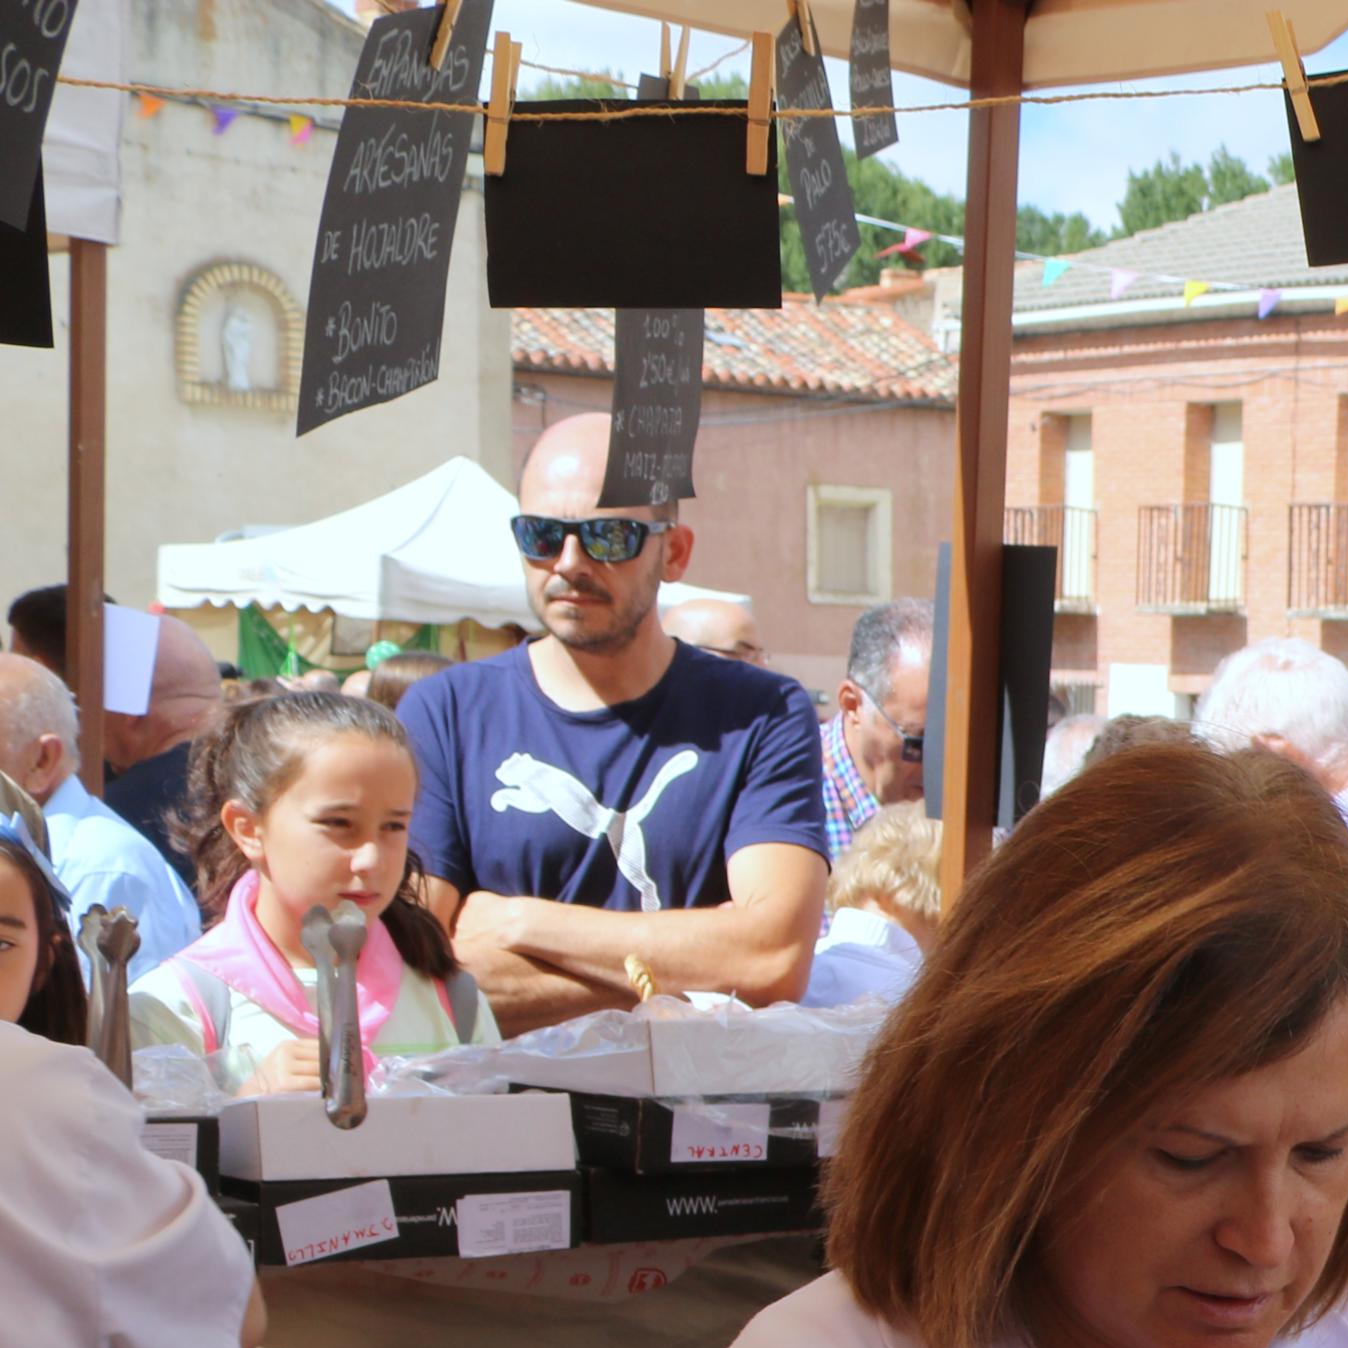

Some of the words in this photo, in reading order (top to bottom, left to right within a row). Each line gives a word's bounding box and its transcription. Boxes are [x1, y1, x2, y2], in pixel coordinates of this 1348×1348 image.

[321, 231, 341, 263] DE
[348, 213, 440, 275] HOJALDRE
[332, 301, 398, 363] BONITO
[687, 1144, 763, 1159] CENTRAL
